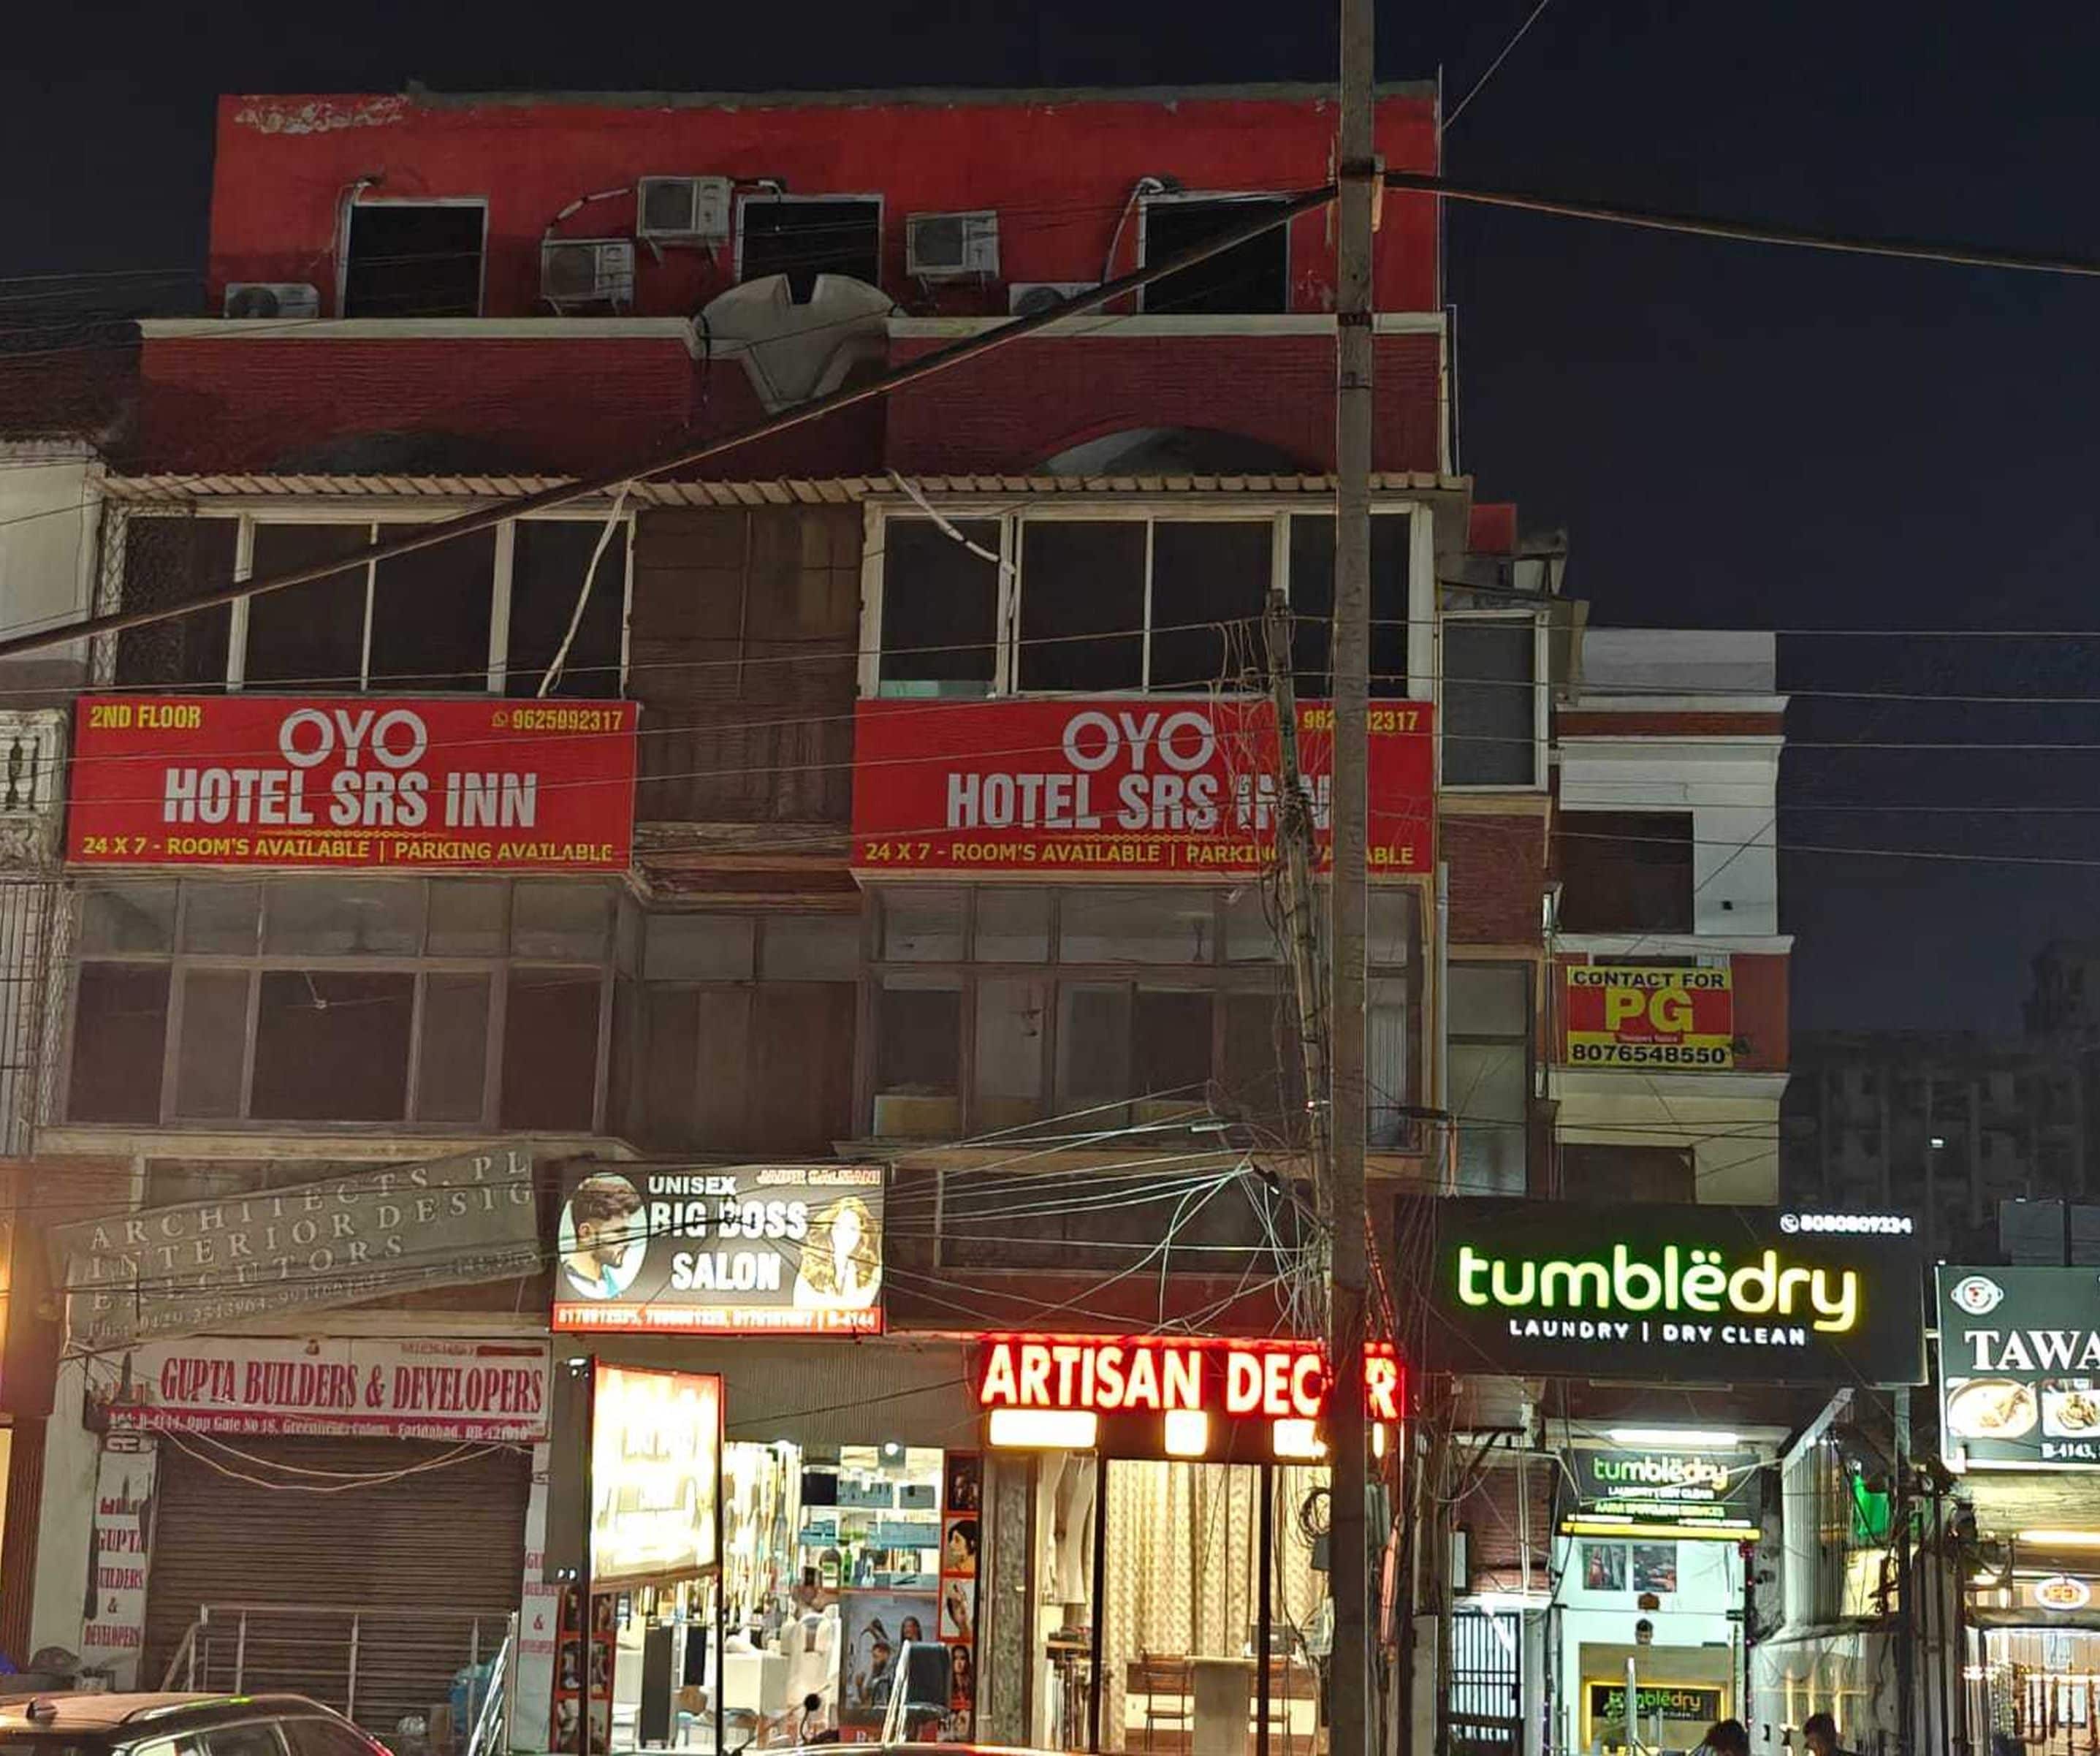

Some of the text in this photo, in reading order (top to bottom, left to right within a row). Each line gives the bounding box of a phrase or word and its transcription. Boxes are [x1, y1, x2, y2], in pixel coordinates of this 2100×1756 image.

[89, 705, 202, 729] 2ND FLOOR
[1304, 709, 1418, 731] 9622317
[278, 708, 428, 769] OYO
[1062, 710, 1217, 773] OYO
[164, 767, 538, 827] HOTEL SRS INN
[946, 772, 1100, 830] HOTEL
[1116, 774, 1218, 831] SRS
[83, 837, 107, 856] 24
[114, 837, 128, 855] X
[134, 837, 147, 856] 7
[167, 837, 249, 856] ROOM'S
[256, 839, 370, 858] AVAILABLE
[395, 841, 492, 859] PARKING
[498, 843, 613, 862] AVAILABLE
[865, 843, 891, 862] 24
[897, 843, 911, 861] X
[918, 843, 931, 861] 7
[951, 843, 1037, 862] ROOM'S
[1042, 844, 1160, 864] AVAILABLE
[1574, 970, 1724, 988] CONTACT FOR
[1605, 987, 1694, 1033] PG
[1572, 1044, 1726, 1065] 8076548550
[648, 1175, 737, 1196] UNISEX
[650, 1201, 807, 1240] BIG BOSS
[89, 1213, 355, 1282] INTERIOR
[671, 1251, 782, 1291] SALON
[1458, 1244, 1857, 1332] tumblëdry
[1510, 1319, 1629, 1340] LAUNDRY
[1663, 1324, 1712, 1343] DRY
[1722, 1325, 1806, 1346] CLEAN
[1964, 1330, 2100, 1371] TAWA
[160, 1357, 544, 1414] GUPTA BUILDERS & DEVELOPERS
[980, 1342, 1398, 1418] ARTISAN DECR
[213, 1417, 240, 1432] Gate
[98, 1567, 144, 1589] UILDERS
[1610, 1689, 1702, 1712] blëdry
